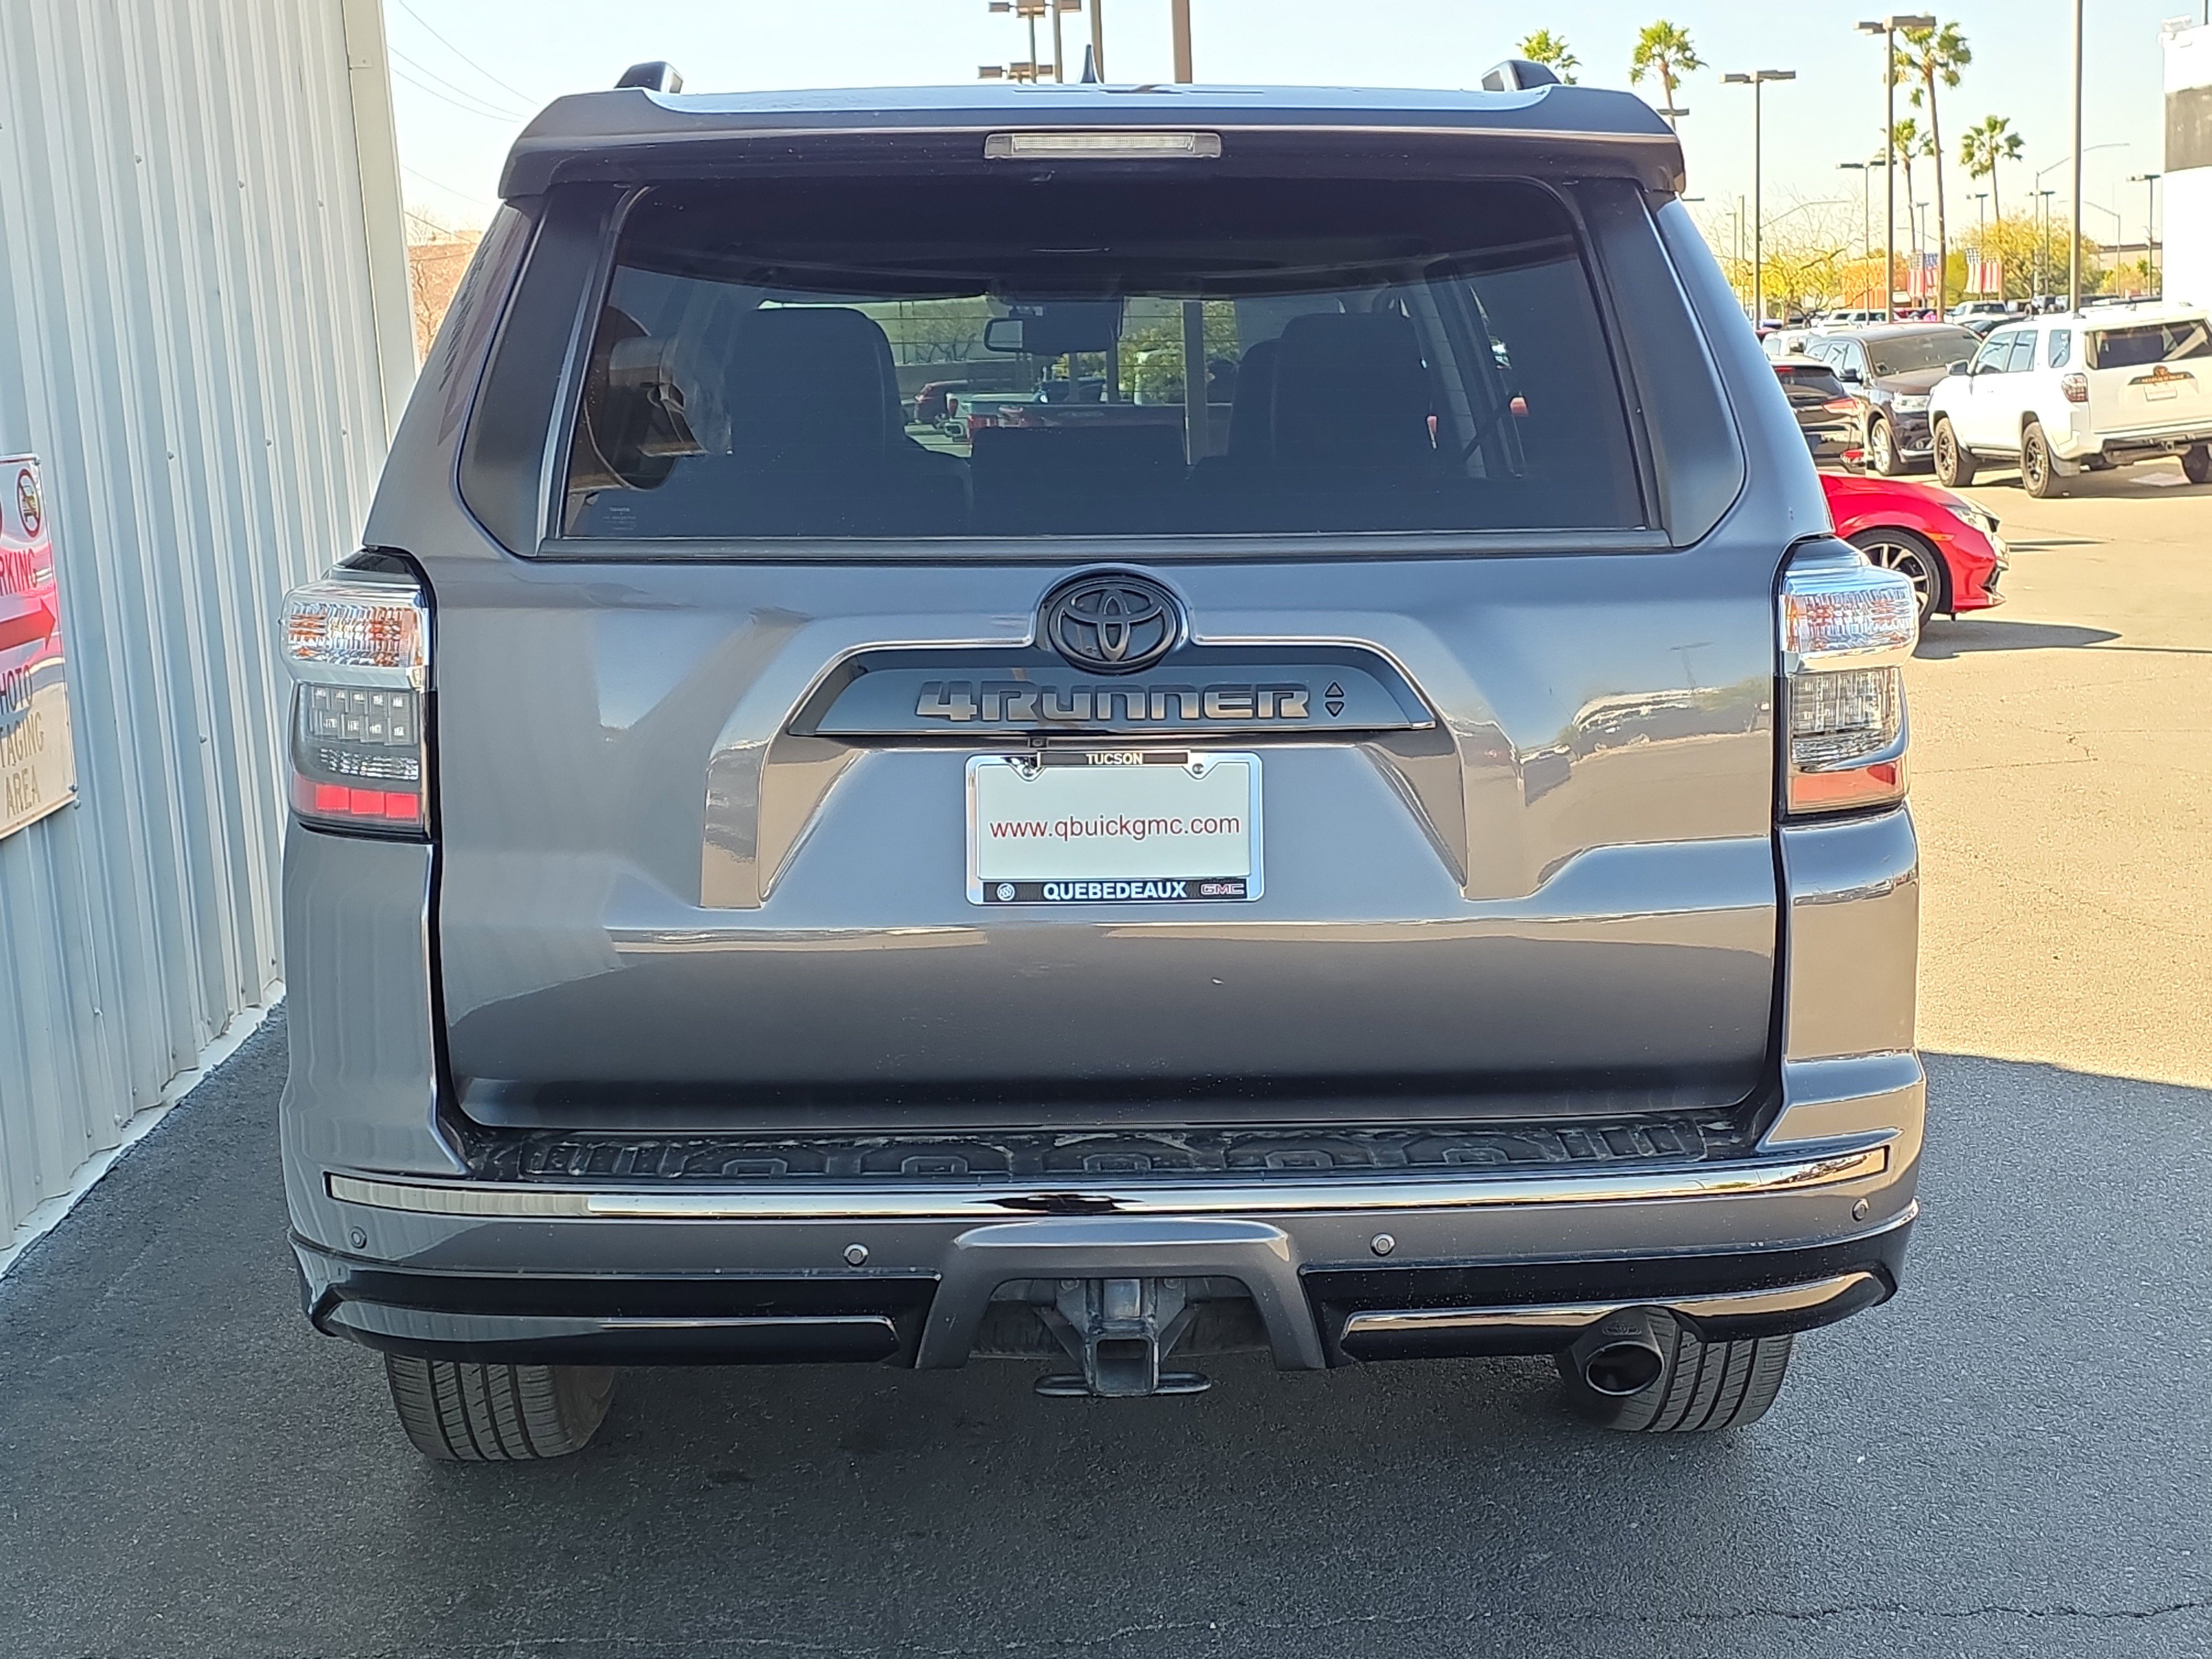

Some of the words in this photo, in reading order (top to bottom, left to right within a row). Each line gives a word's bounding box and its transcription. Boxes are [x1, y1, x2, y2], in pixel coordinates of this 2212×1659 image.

[915, 680, 1310, 722] 4RUNNER
[1085, 753, 1143, 766] TUCSON
[5, 764, 41, 819] AREA
[989, 814, 1240, 841] www.qbuickgmc.com
[1043, 881, 1187, 900] QUEBEDEAUX
[1200, 883, 1245, 895] GMC
